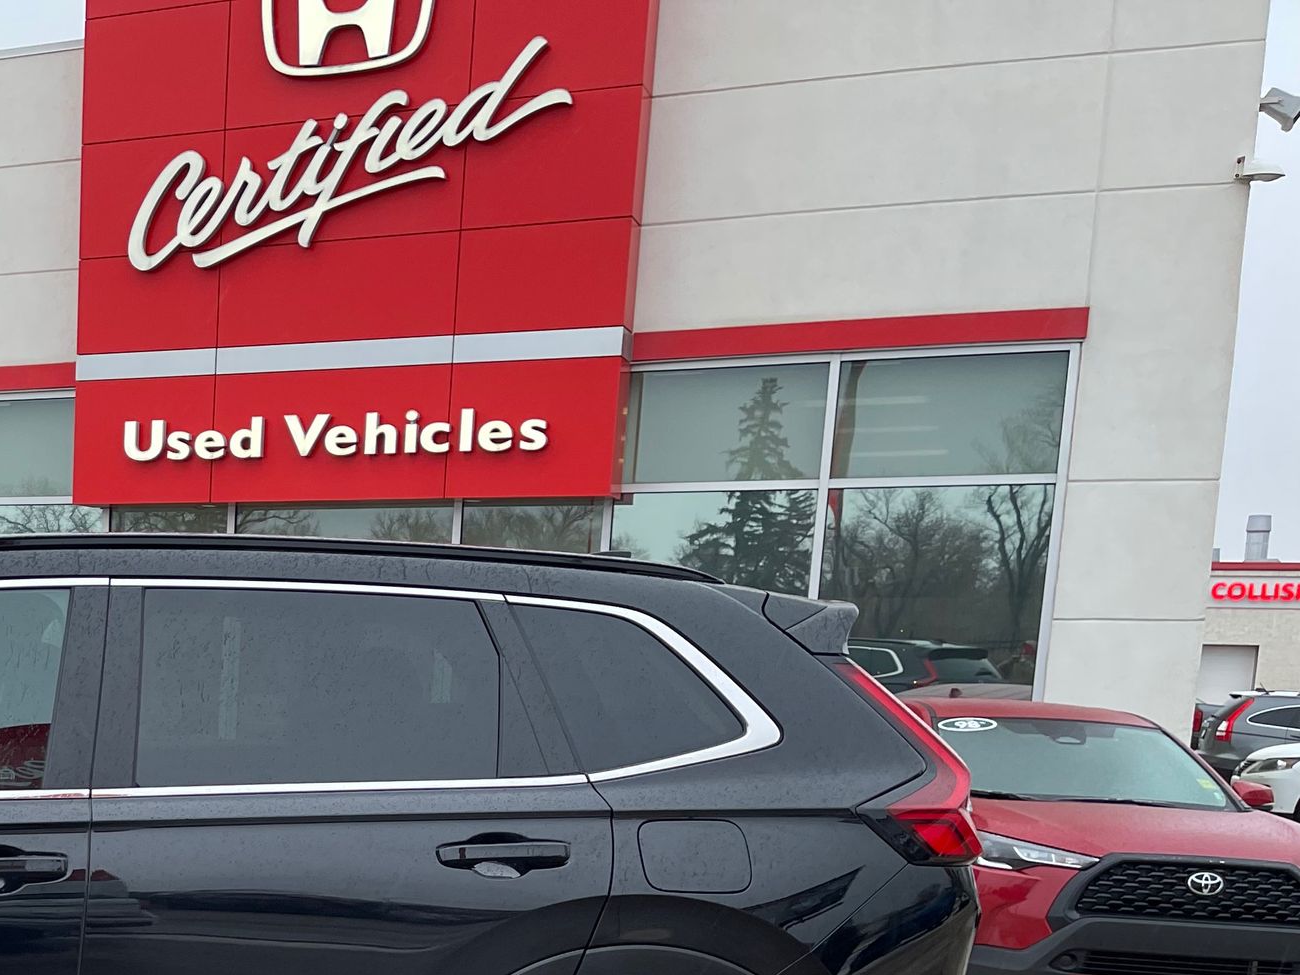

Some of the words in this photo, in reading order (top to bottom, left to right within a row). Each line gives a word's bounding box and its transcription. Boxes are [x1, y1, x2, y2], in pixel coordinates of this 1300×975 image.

[127, 35, 573, 271] Certified
[123, 415, 265, 461] Used
[284, 407, 548, 456] Vehicles
